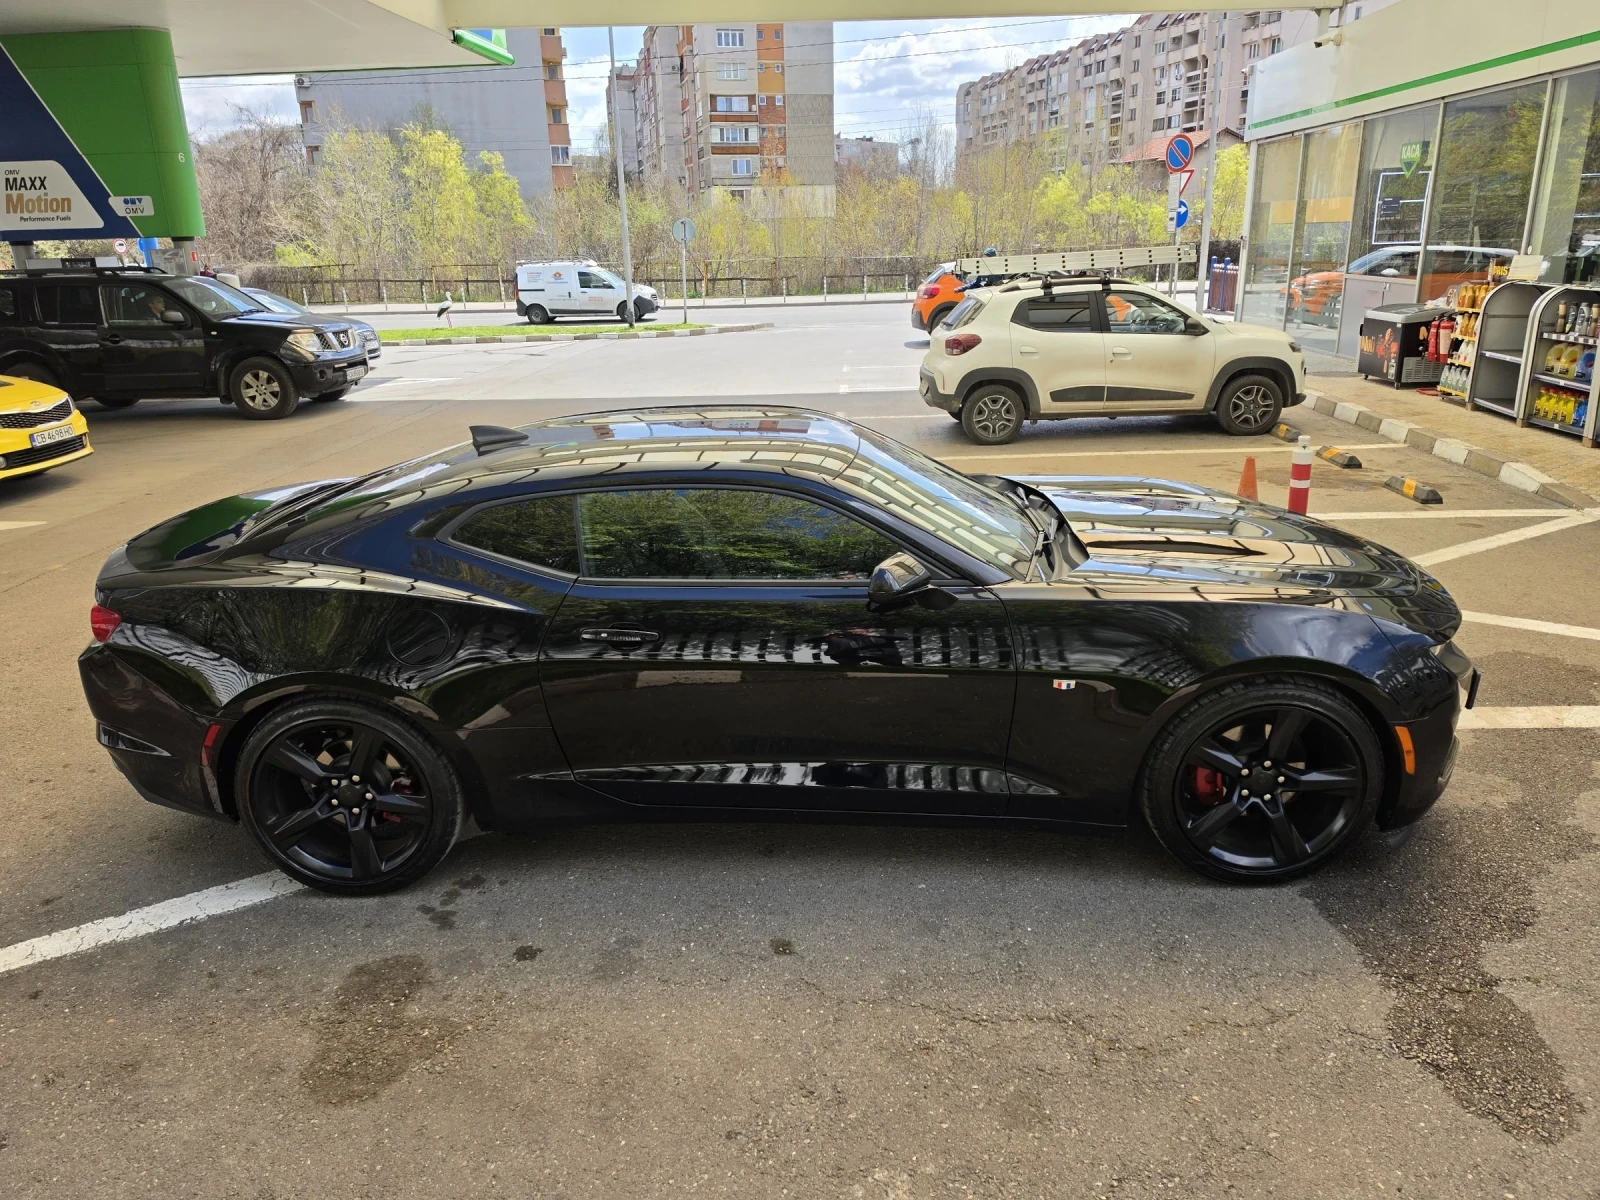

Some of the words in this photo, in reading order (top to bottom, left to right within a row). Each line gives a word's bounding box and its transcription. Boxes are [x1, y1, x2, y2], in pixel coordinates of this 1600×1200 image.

[178, 152, 185, 162] 6
[5, 176, 47, 191] MAXX
[5, 192, 72, 214] Motion
